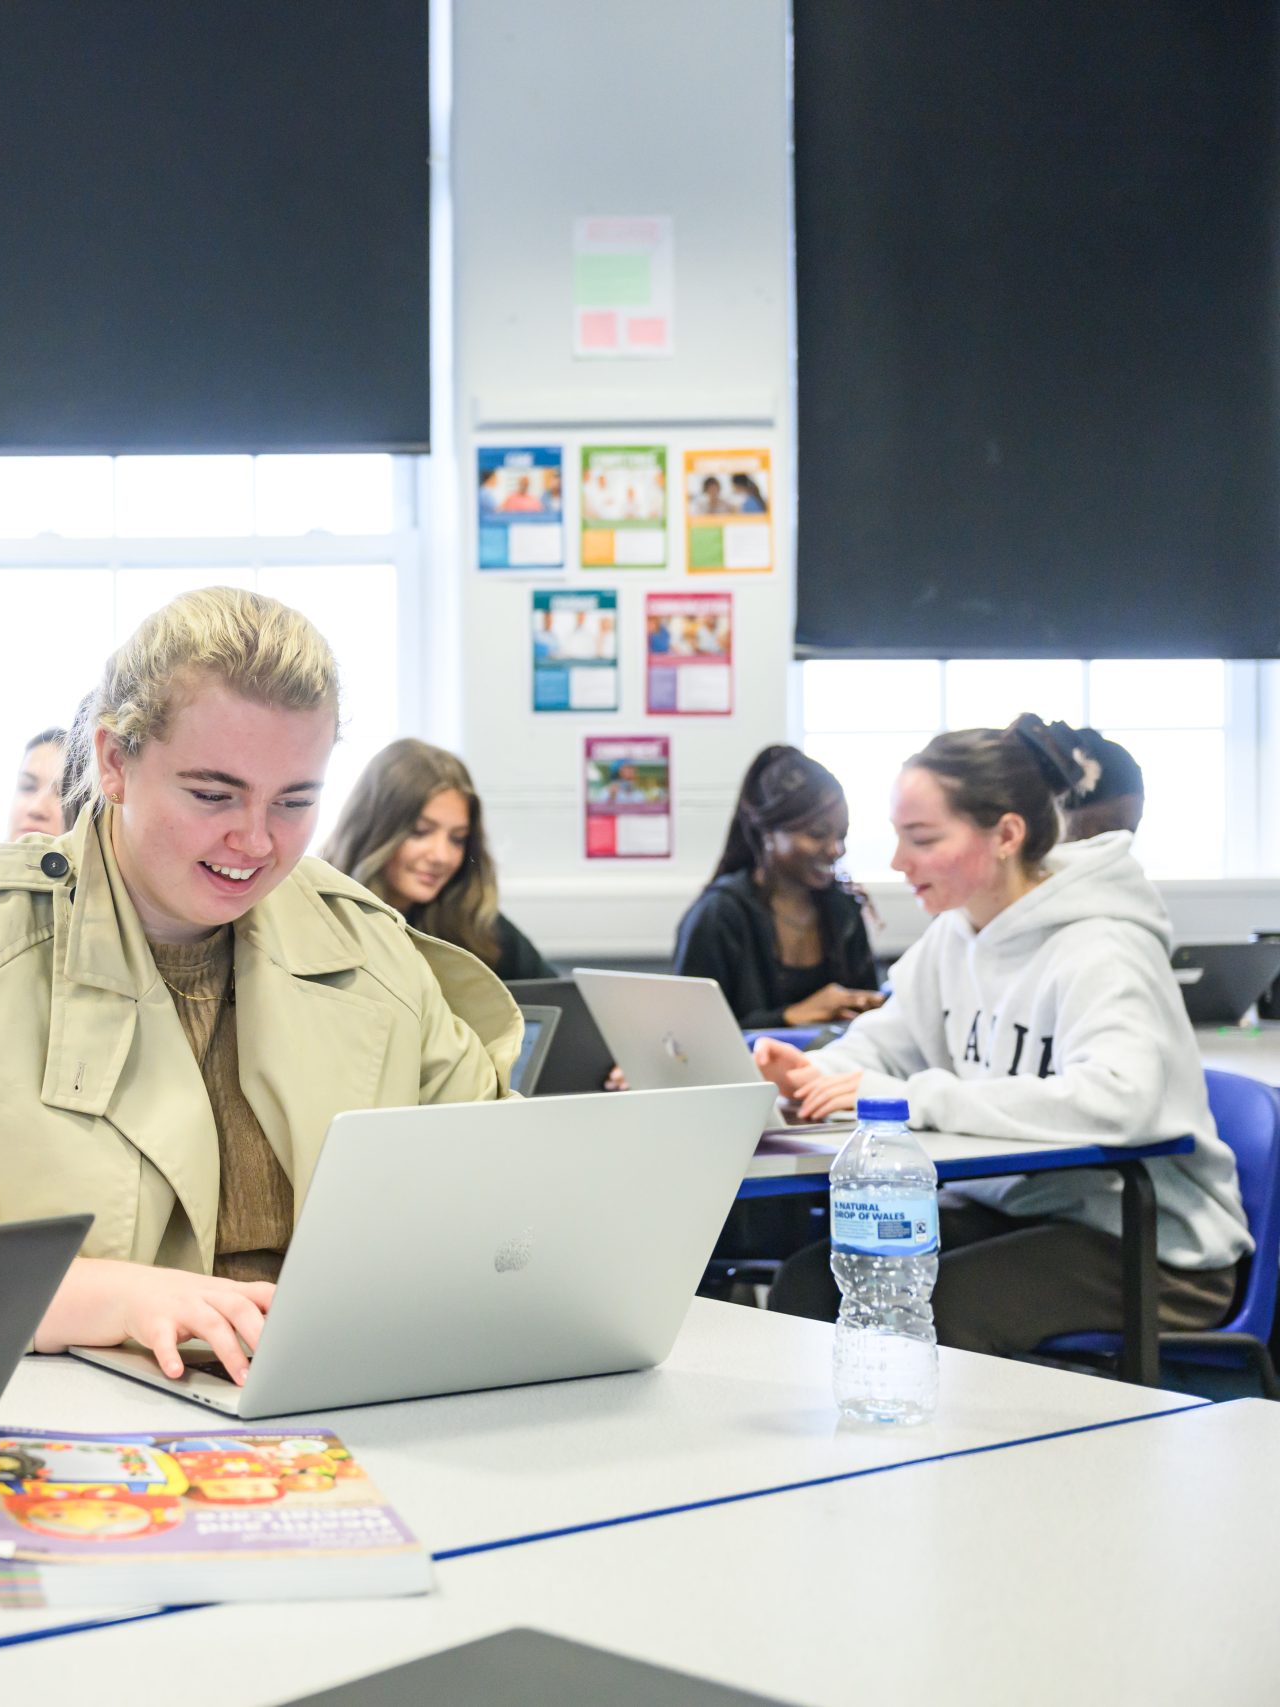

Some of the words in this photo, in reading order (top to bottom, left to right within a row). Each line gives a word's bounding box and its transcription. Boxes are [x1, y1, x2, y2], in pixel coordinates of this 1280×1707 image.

[840, 1202, 880, 1211] NATURAL
[858, 1212, 870, 1220] OF
[872, 1212, 905, 1221] WALES
